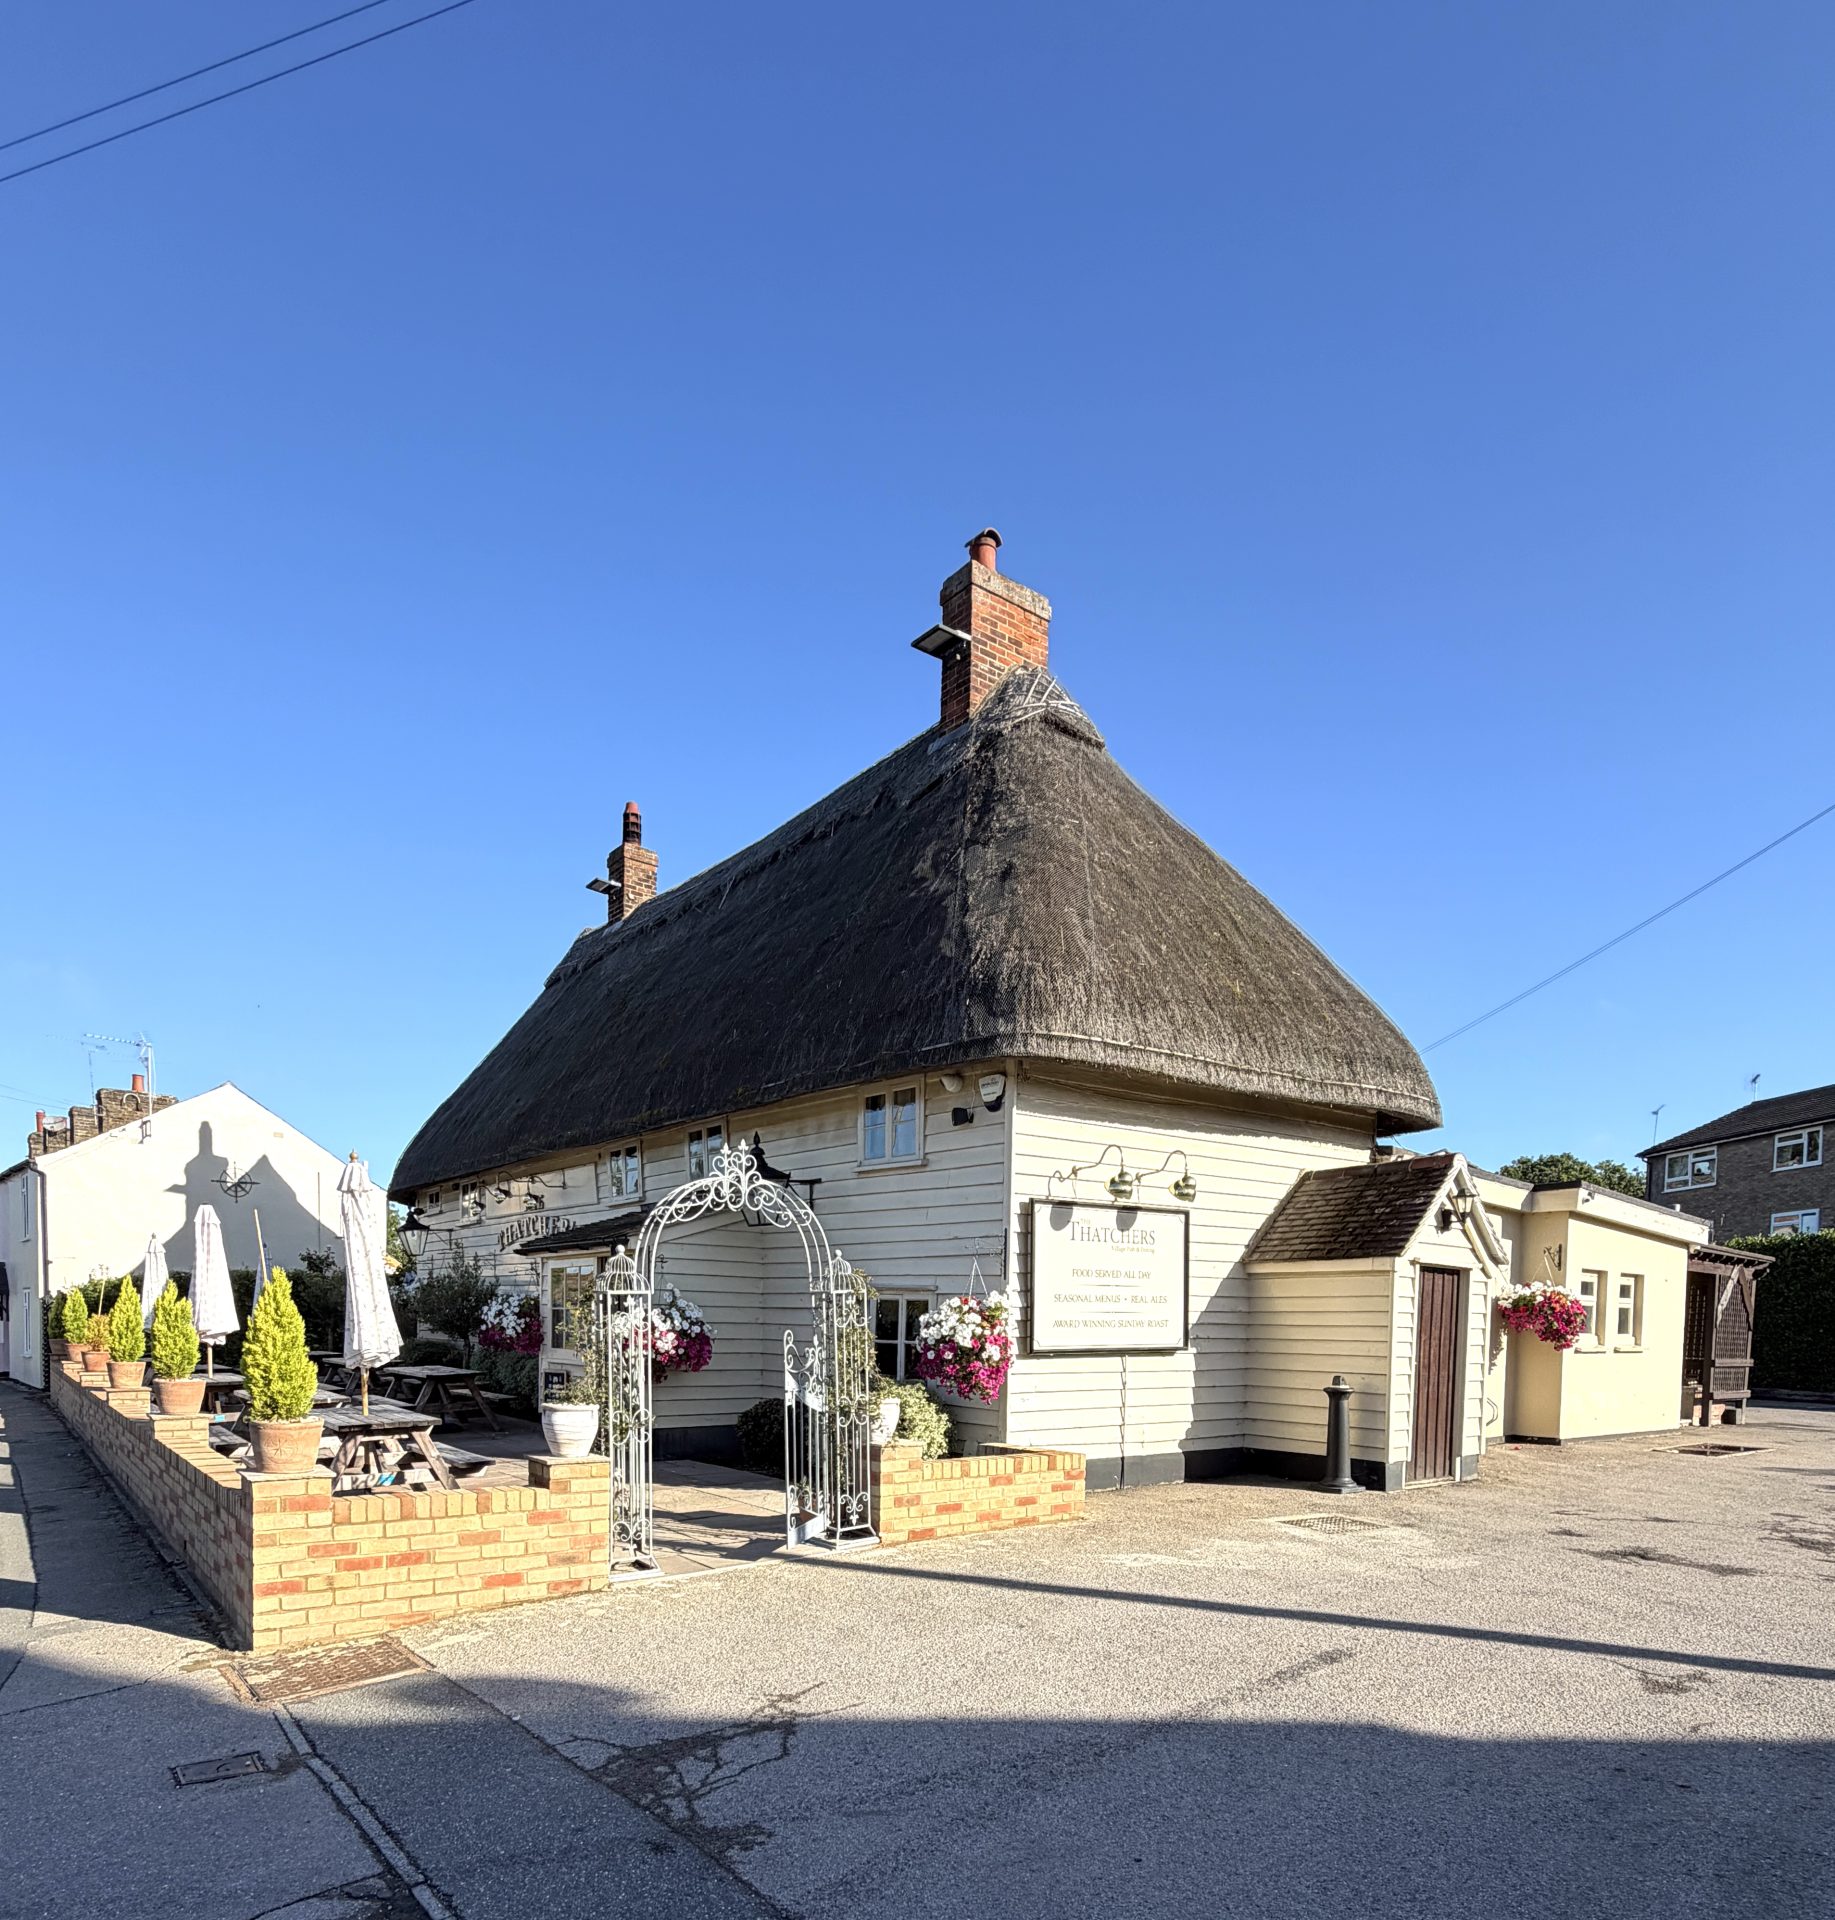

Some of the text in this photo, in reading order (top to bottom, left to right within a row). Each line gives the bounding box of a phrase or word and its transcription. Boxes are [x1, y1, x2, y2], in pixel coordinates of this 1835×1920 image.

[1070, 1220, 1155, 1245] THATCHERS
[1072, 1268, 1151, 1279] FOOD SERVED ALL DAY
[1054, 1293, 1168, 1304] SEASONAL MENUS REAL ALES
[1053, 1319, 1169, 1328] AWARD WINNING SUNDAY ROAST
